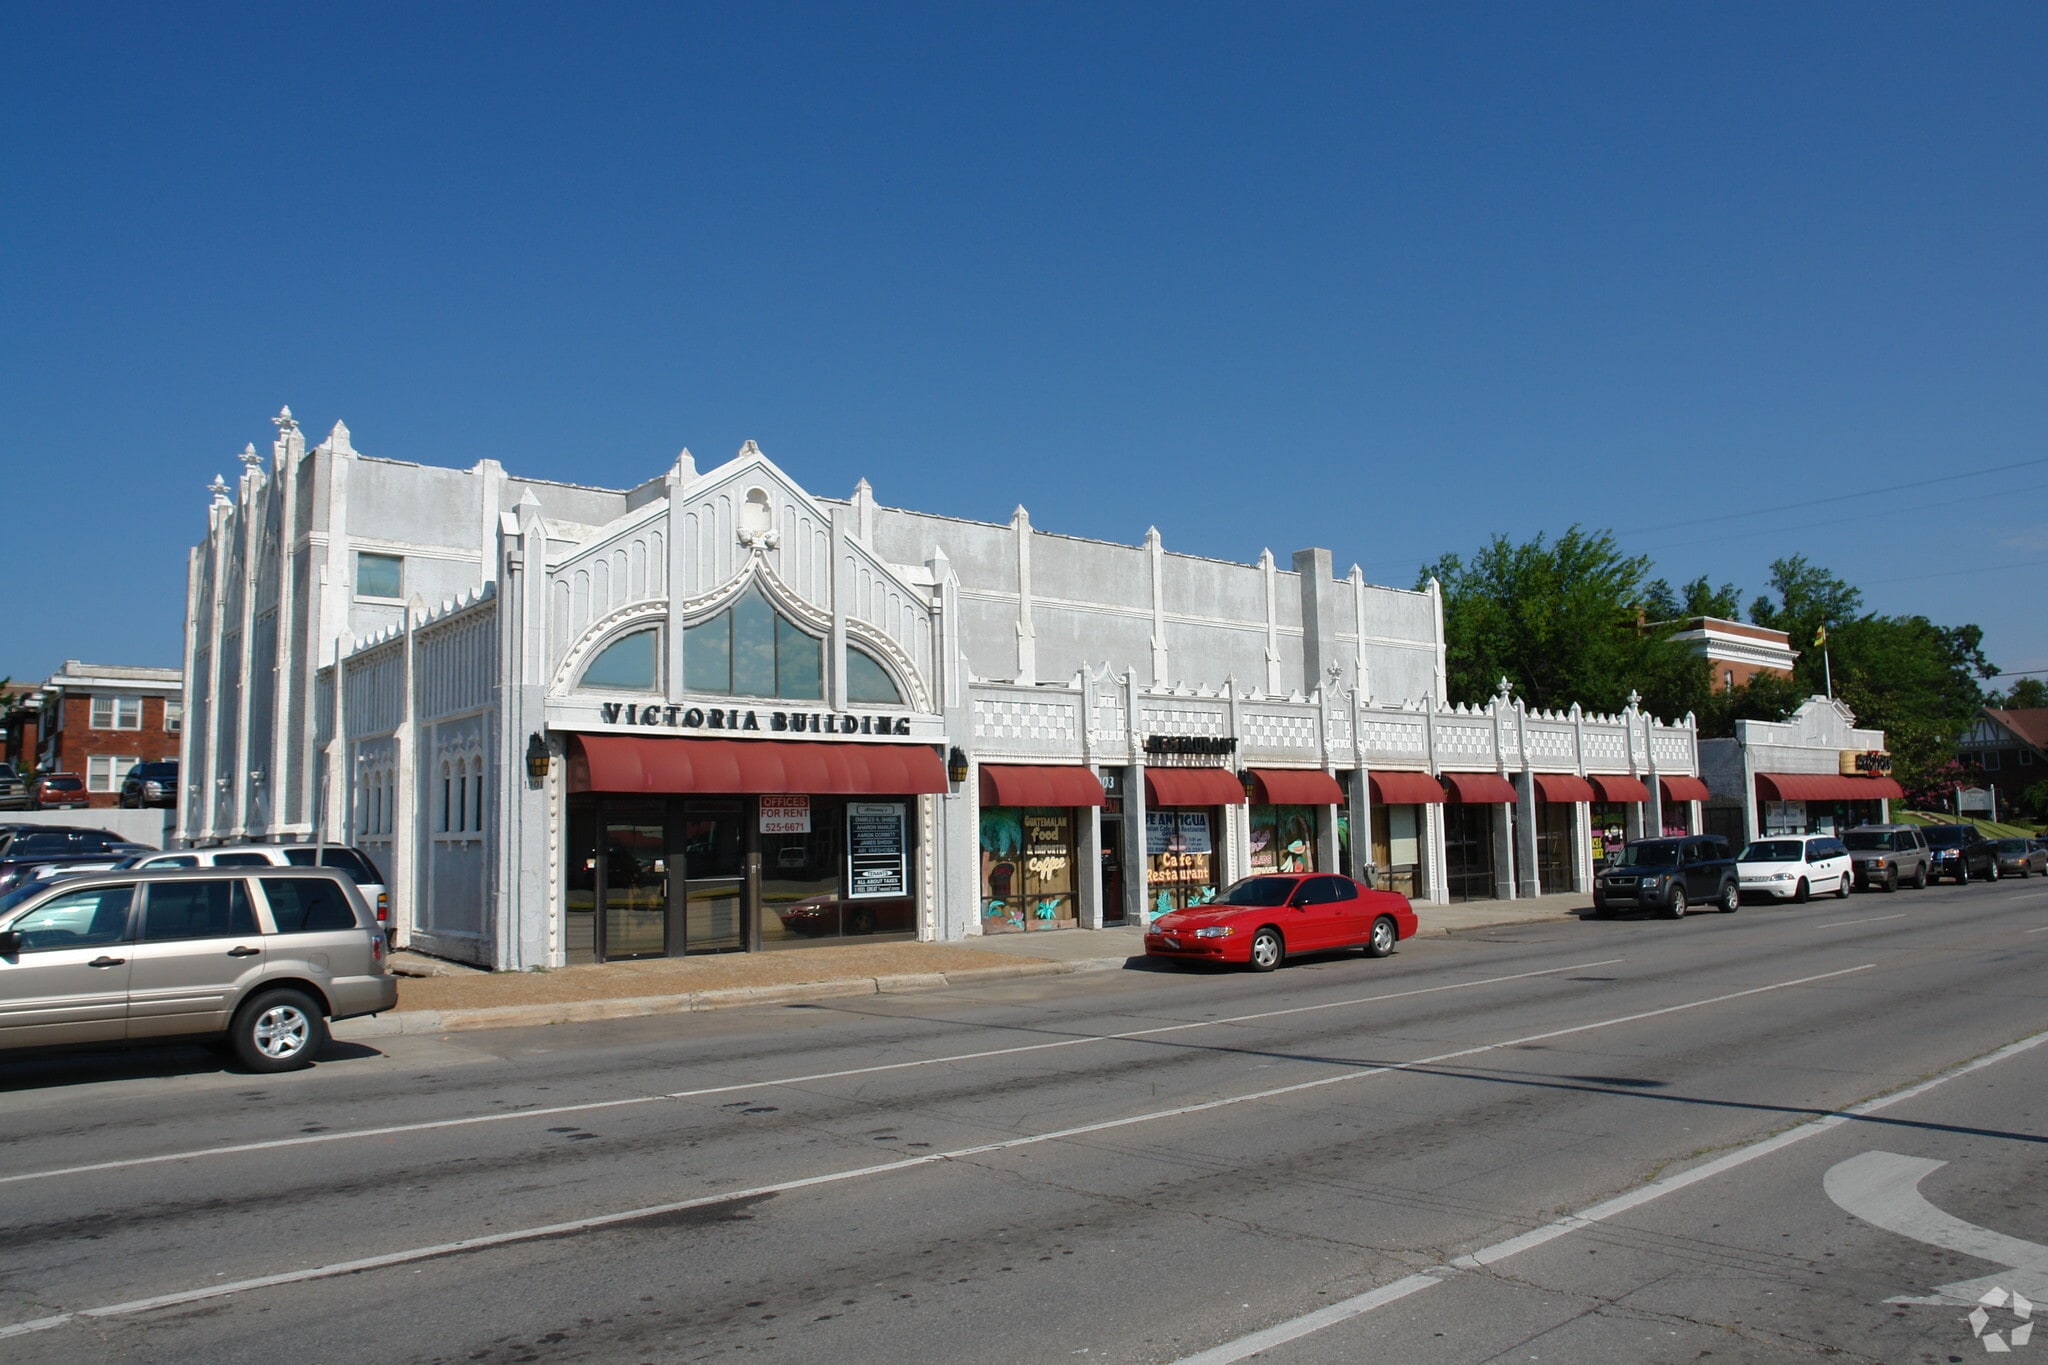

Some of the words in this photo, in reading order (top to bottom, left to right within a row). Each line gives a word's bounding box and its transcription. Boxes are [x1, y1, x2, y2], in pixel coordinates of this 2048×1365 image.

[602, 702, 760, 731] VICTORIA
[771, 711, 911, 736] BUILDING
[1146, 735, 1239, 755] RESTAURANT
[763, 797, 807, 807] OFFICES
[760, 808, 781, 818] FOR
[783, 808, 809, 818] RENT
[765, 822, 804, 832] 525-6671
[1031, 826, 1059, 842] food
[1034, 844, 1067, 855] IMPORTED
[1162, 852, 1192, 866] Cafe
[1196, 852, 1204, 866] &
[1028, 856, 1066, 881] Coffee
[1146, 867, 1209, 883] Restaurant
